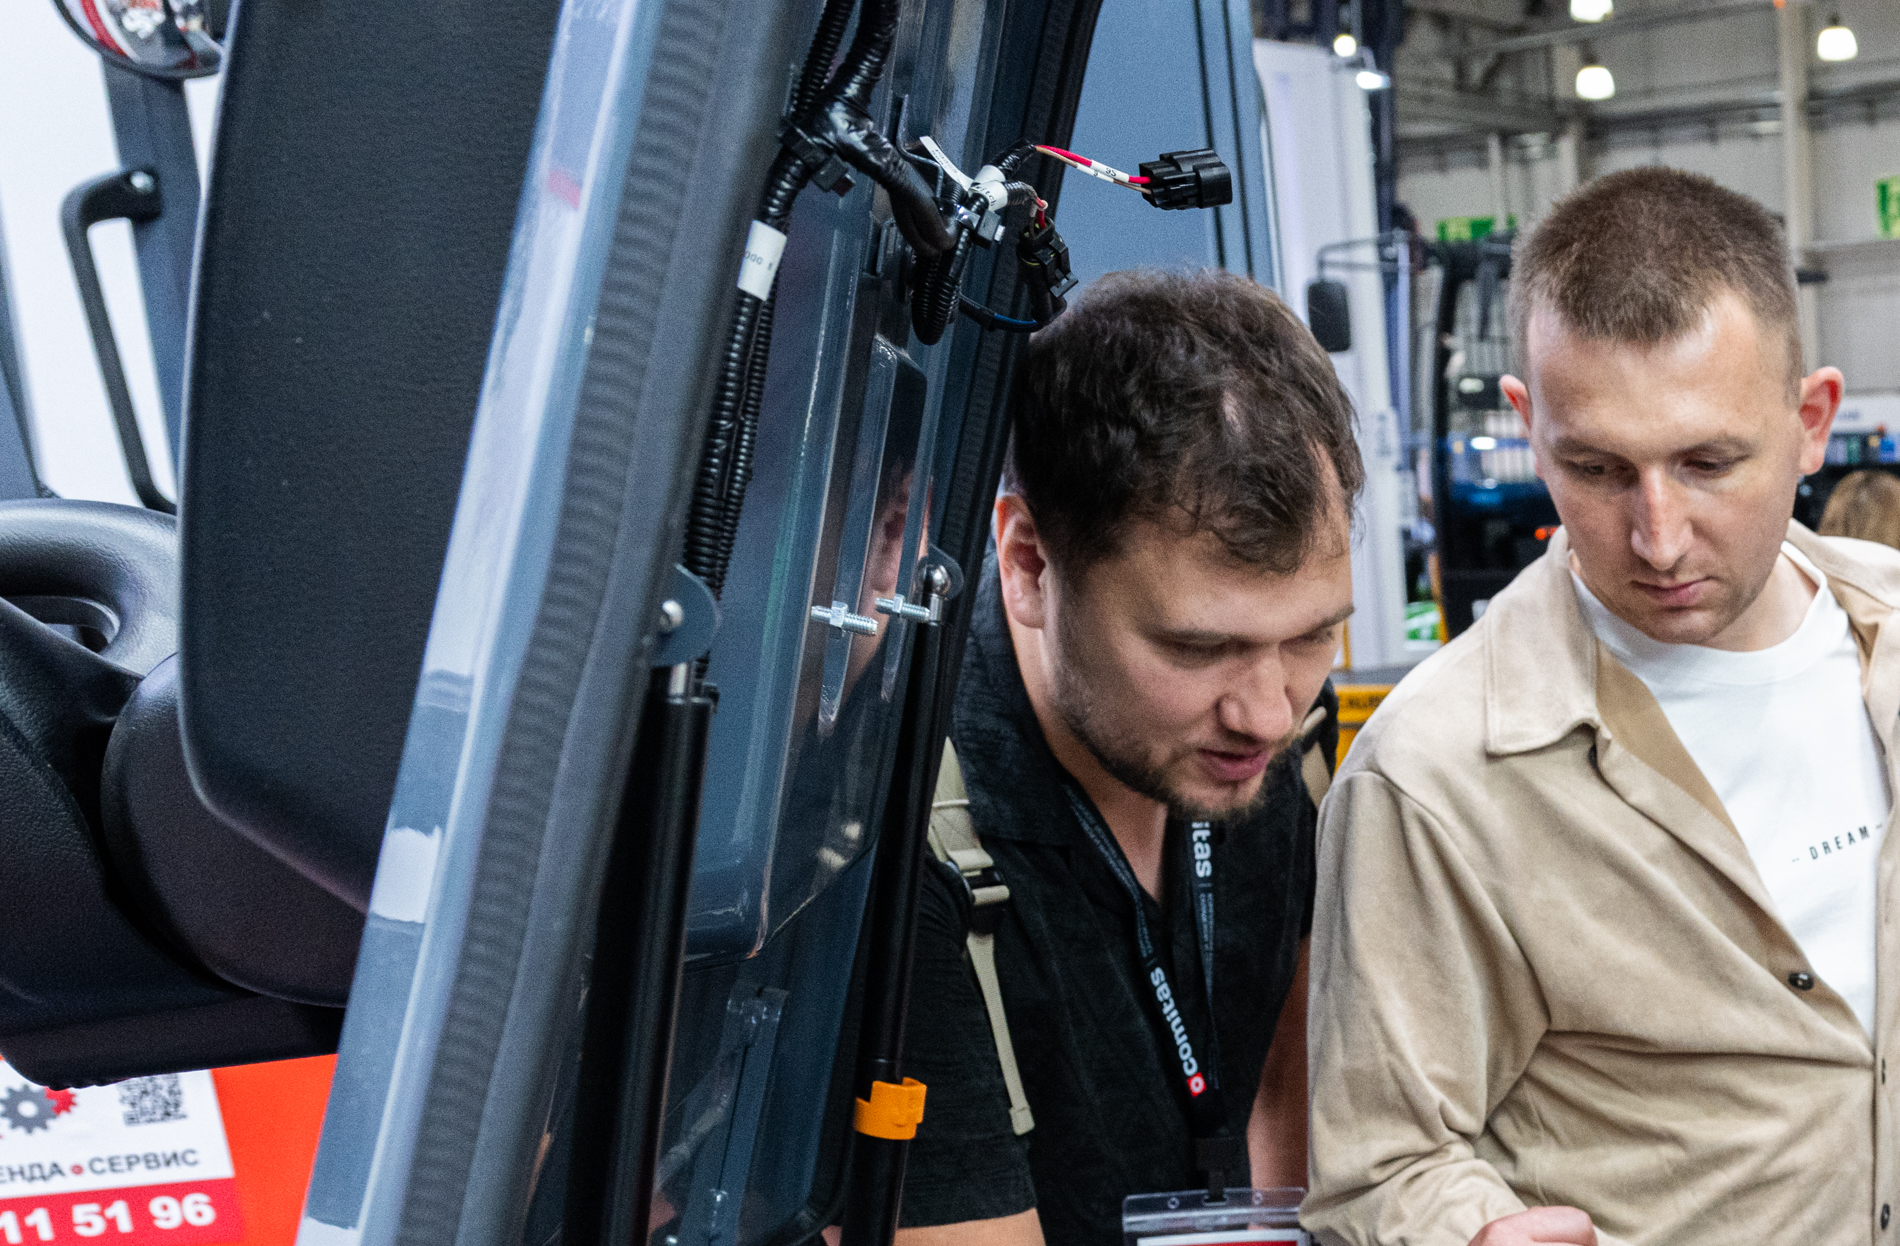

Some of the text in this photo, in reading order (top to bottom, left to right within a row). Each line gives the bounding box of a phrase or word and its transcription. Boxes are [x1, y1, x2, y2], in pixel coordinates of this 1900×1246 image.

[1192, 822, 1213, 878] itas
[1809, 825, 1870, 860] DREAM
[1150, 967, 1199, 1076] comitas
[88, 1148, 200, 1176] СЕРВИС
[72, 1199, 134, 1237] 51
[148, 1192, 216, 1230] 96
